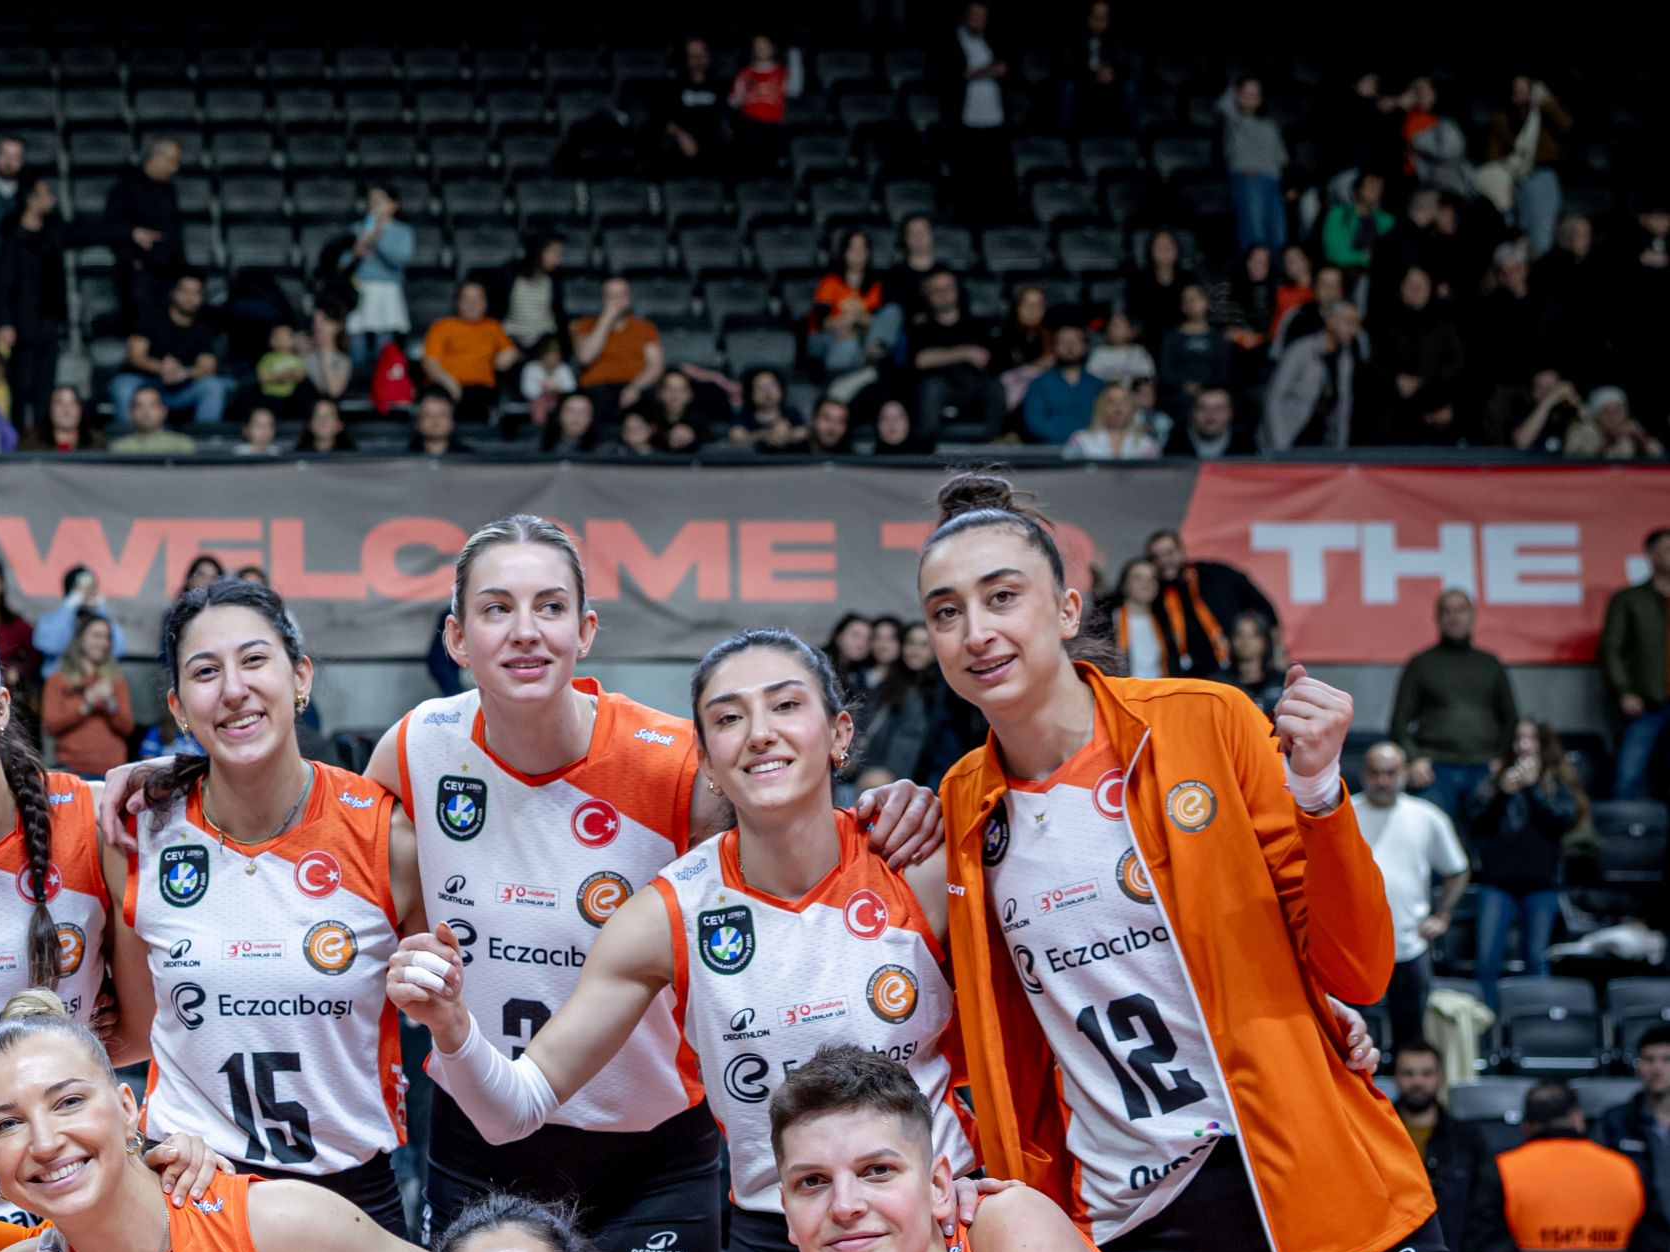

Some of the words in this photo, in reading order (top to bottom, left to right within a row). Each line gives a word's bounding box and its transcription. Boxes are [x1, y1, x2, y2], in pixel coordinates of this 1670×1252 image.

[1250, 521, 1583, 606] THE
[634, 728, 676, 746] Selpak
[444, 781, 465, 791] CEV
[165, 851, 185, 861] CEV
[438, 892, 475, 907] DECATHLON
[703, 914, 726, 926] CEV
[163, 960, 201, 968] DECATHLON
[218, 994, 353, 1020] Eczacıbaşı
[812, 1000, 844, 1011] vodafone
[723, 1029, 771, 1042] DECATHLON
[1076, 993, 1208, 1121] 12
[217, 1052, 318, 1164] 15
